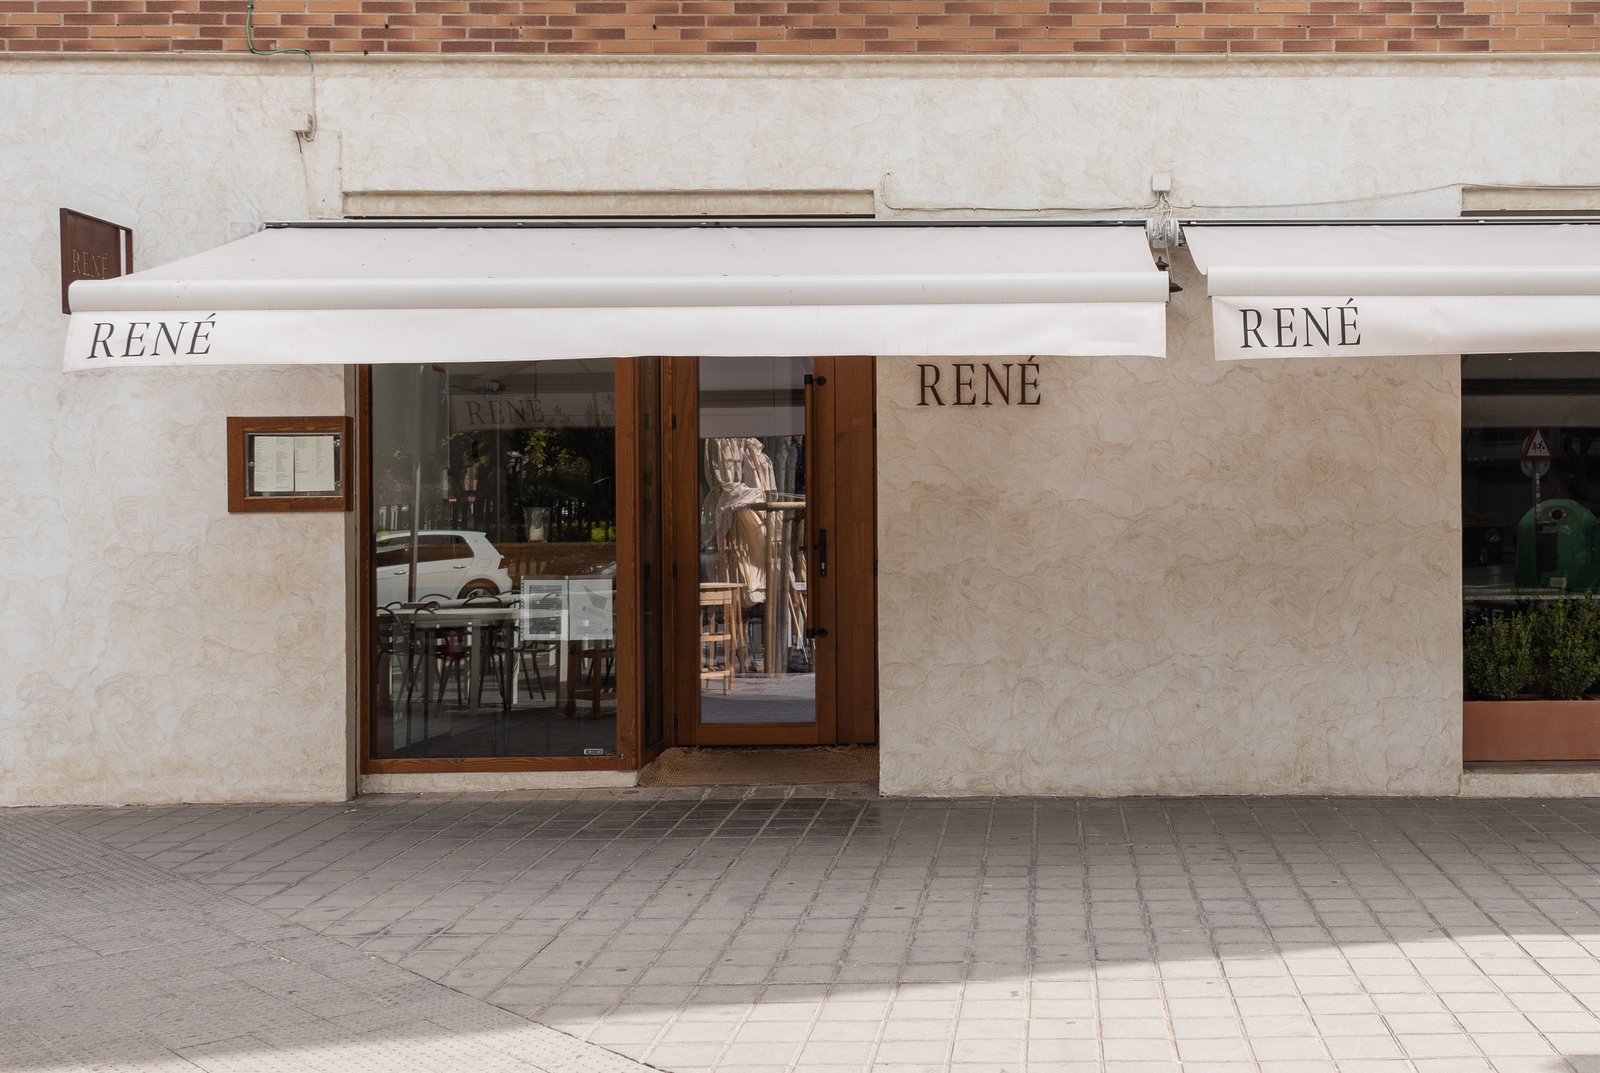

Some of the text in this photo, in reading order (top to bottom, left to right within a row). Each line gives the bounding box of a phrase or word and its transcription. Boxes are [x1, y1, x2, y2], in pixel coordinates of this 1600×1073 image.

[72, 248, 109, 280] RENÉ
[86, 312, 217, 360] RENÉ
[1238, 297, 1361, 349] RENÉ
[916, 355, 1042, 406] RENÉ
